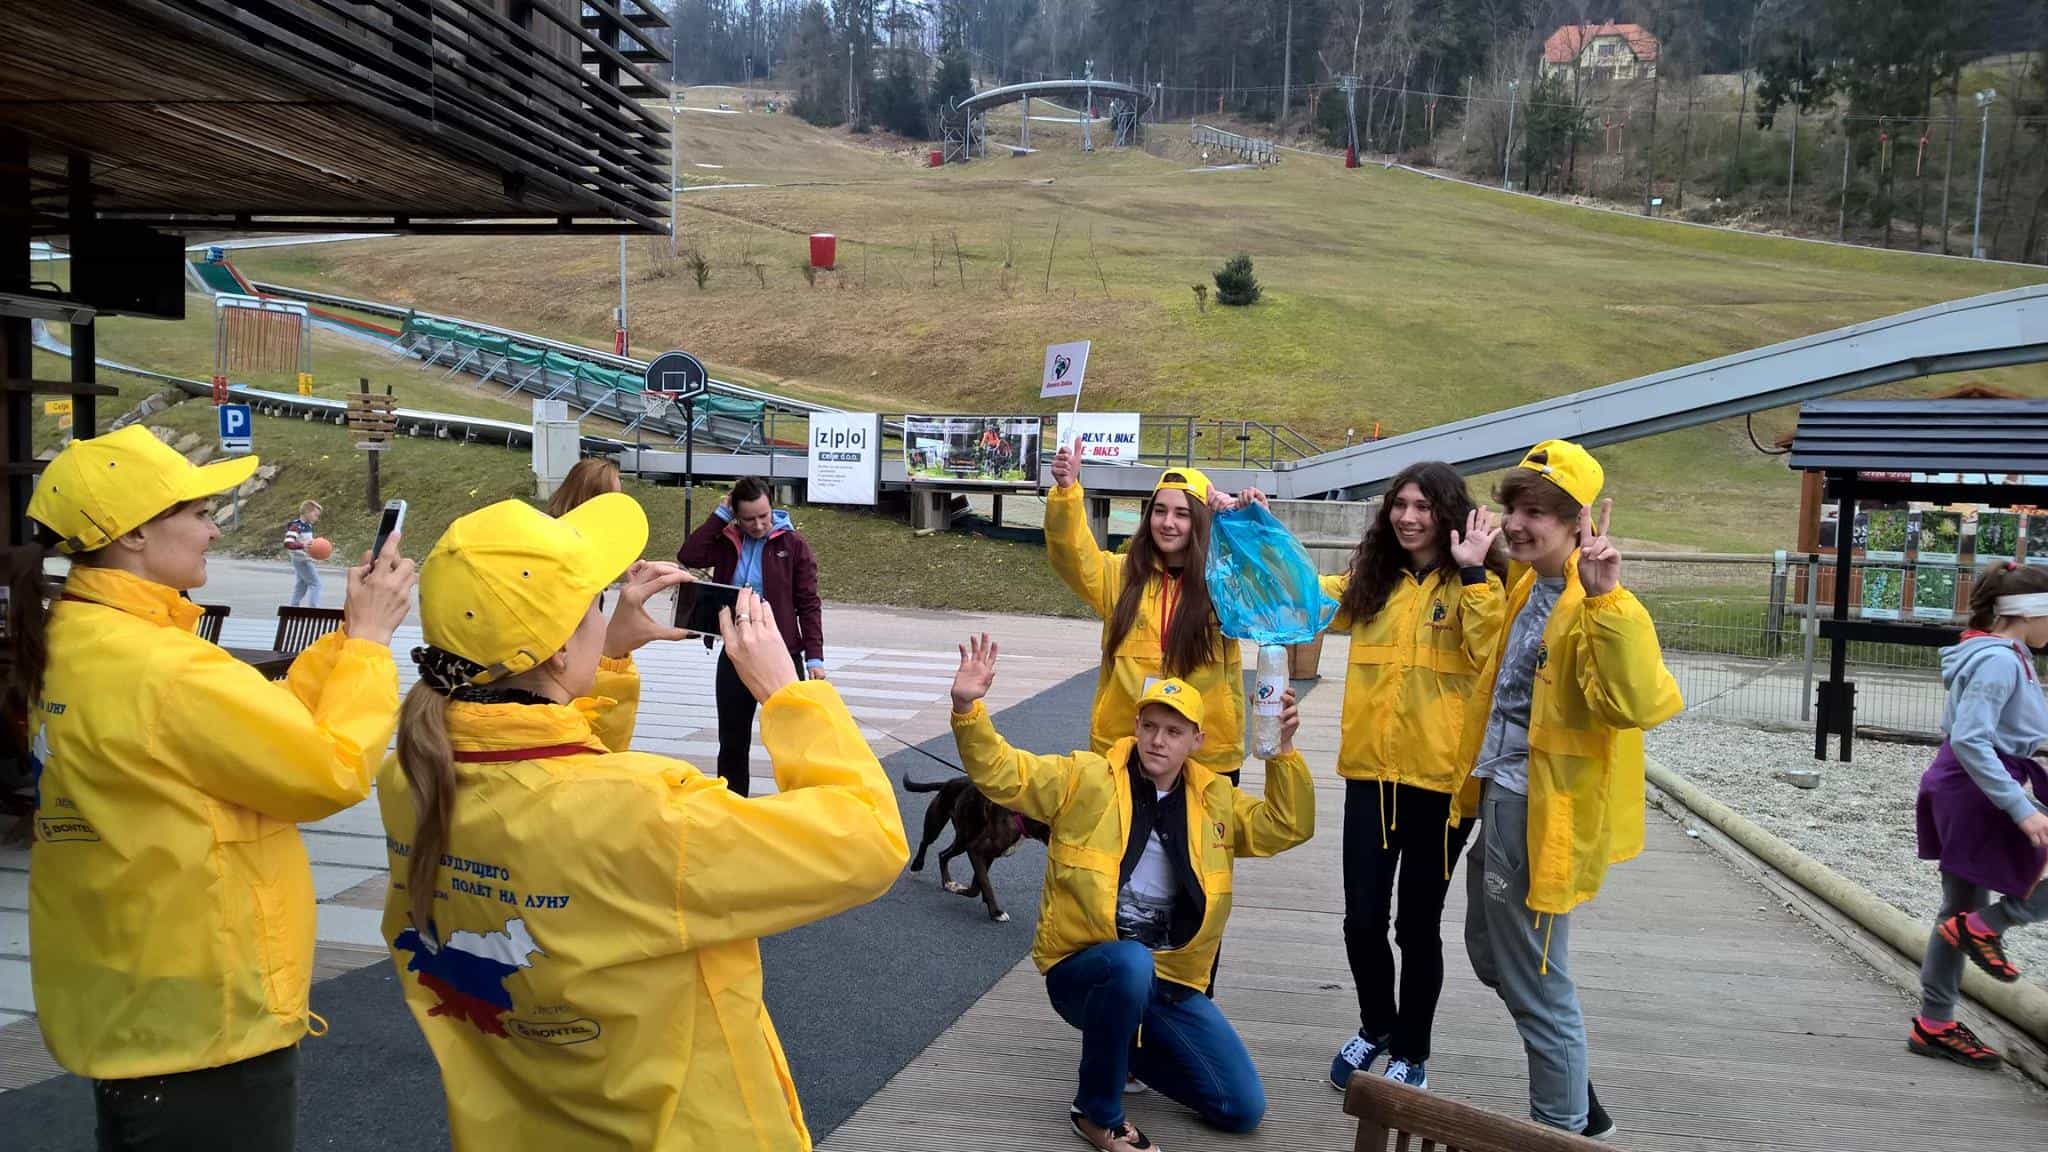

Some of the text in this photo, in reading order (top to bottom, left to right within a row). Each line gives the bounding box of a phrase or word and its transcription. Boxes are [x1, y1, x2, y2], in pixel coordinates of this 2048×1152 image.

[227, 409, 244, 434] P
[1081, 432, 1136, 443] RENT A BIKE
[1081, 446, 1087, 456] E
[1093, 446, 1120, 457] BIKES
[499, 889, 518, 906] НА
[525, 894, 570, 909] ЛУНУ
